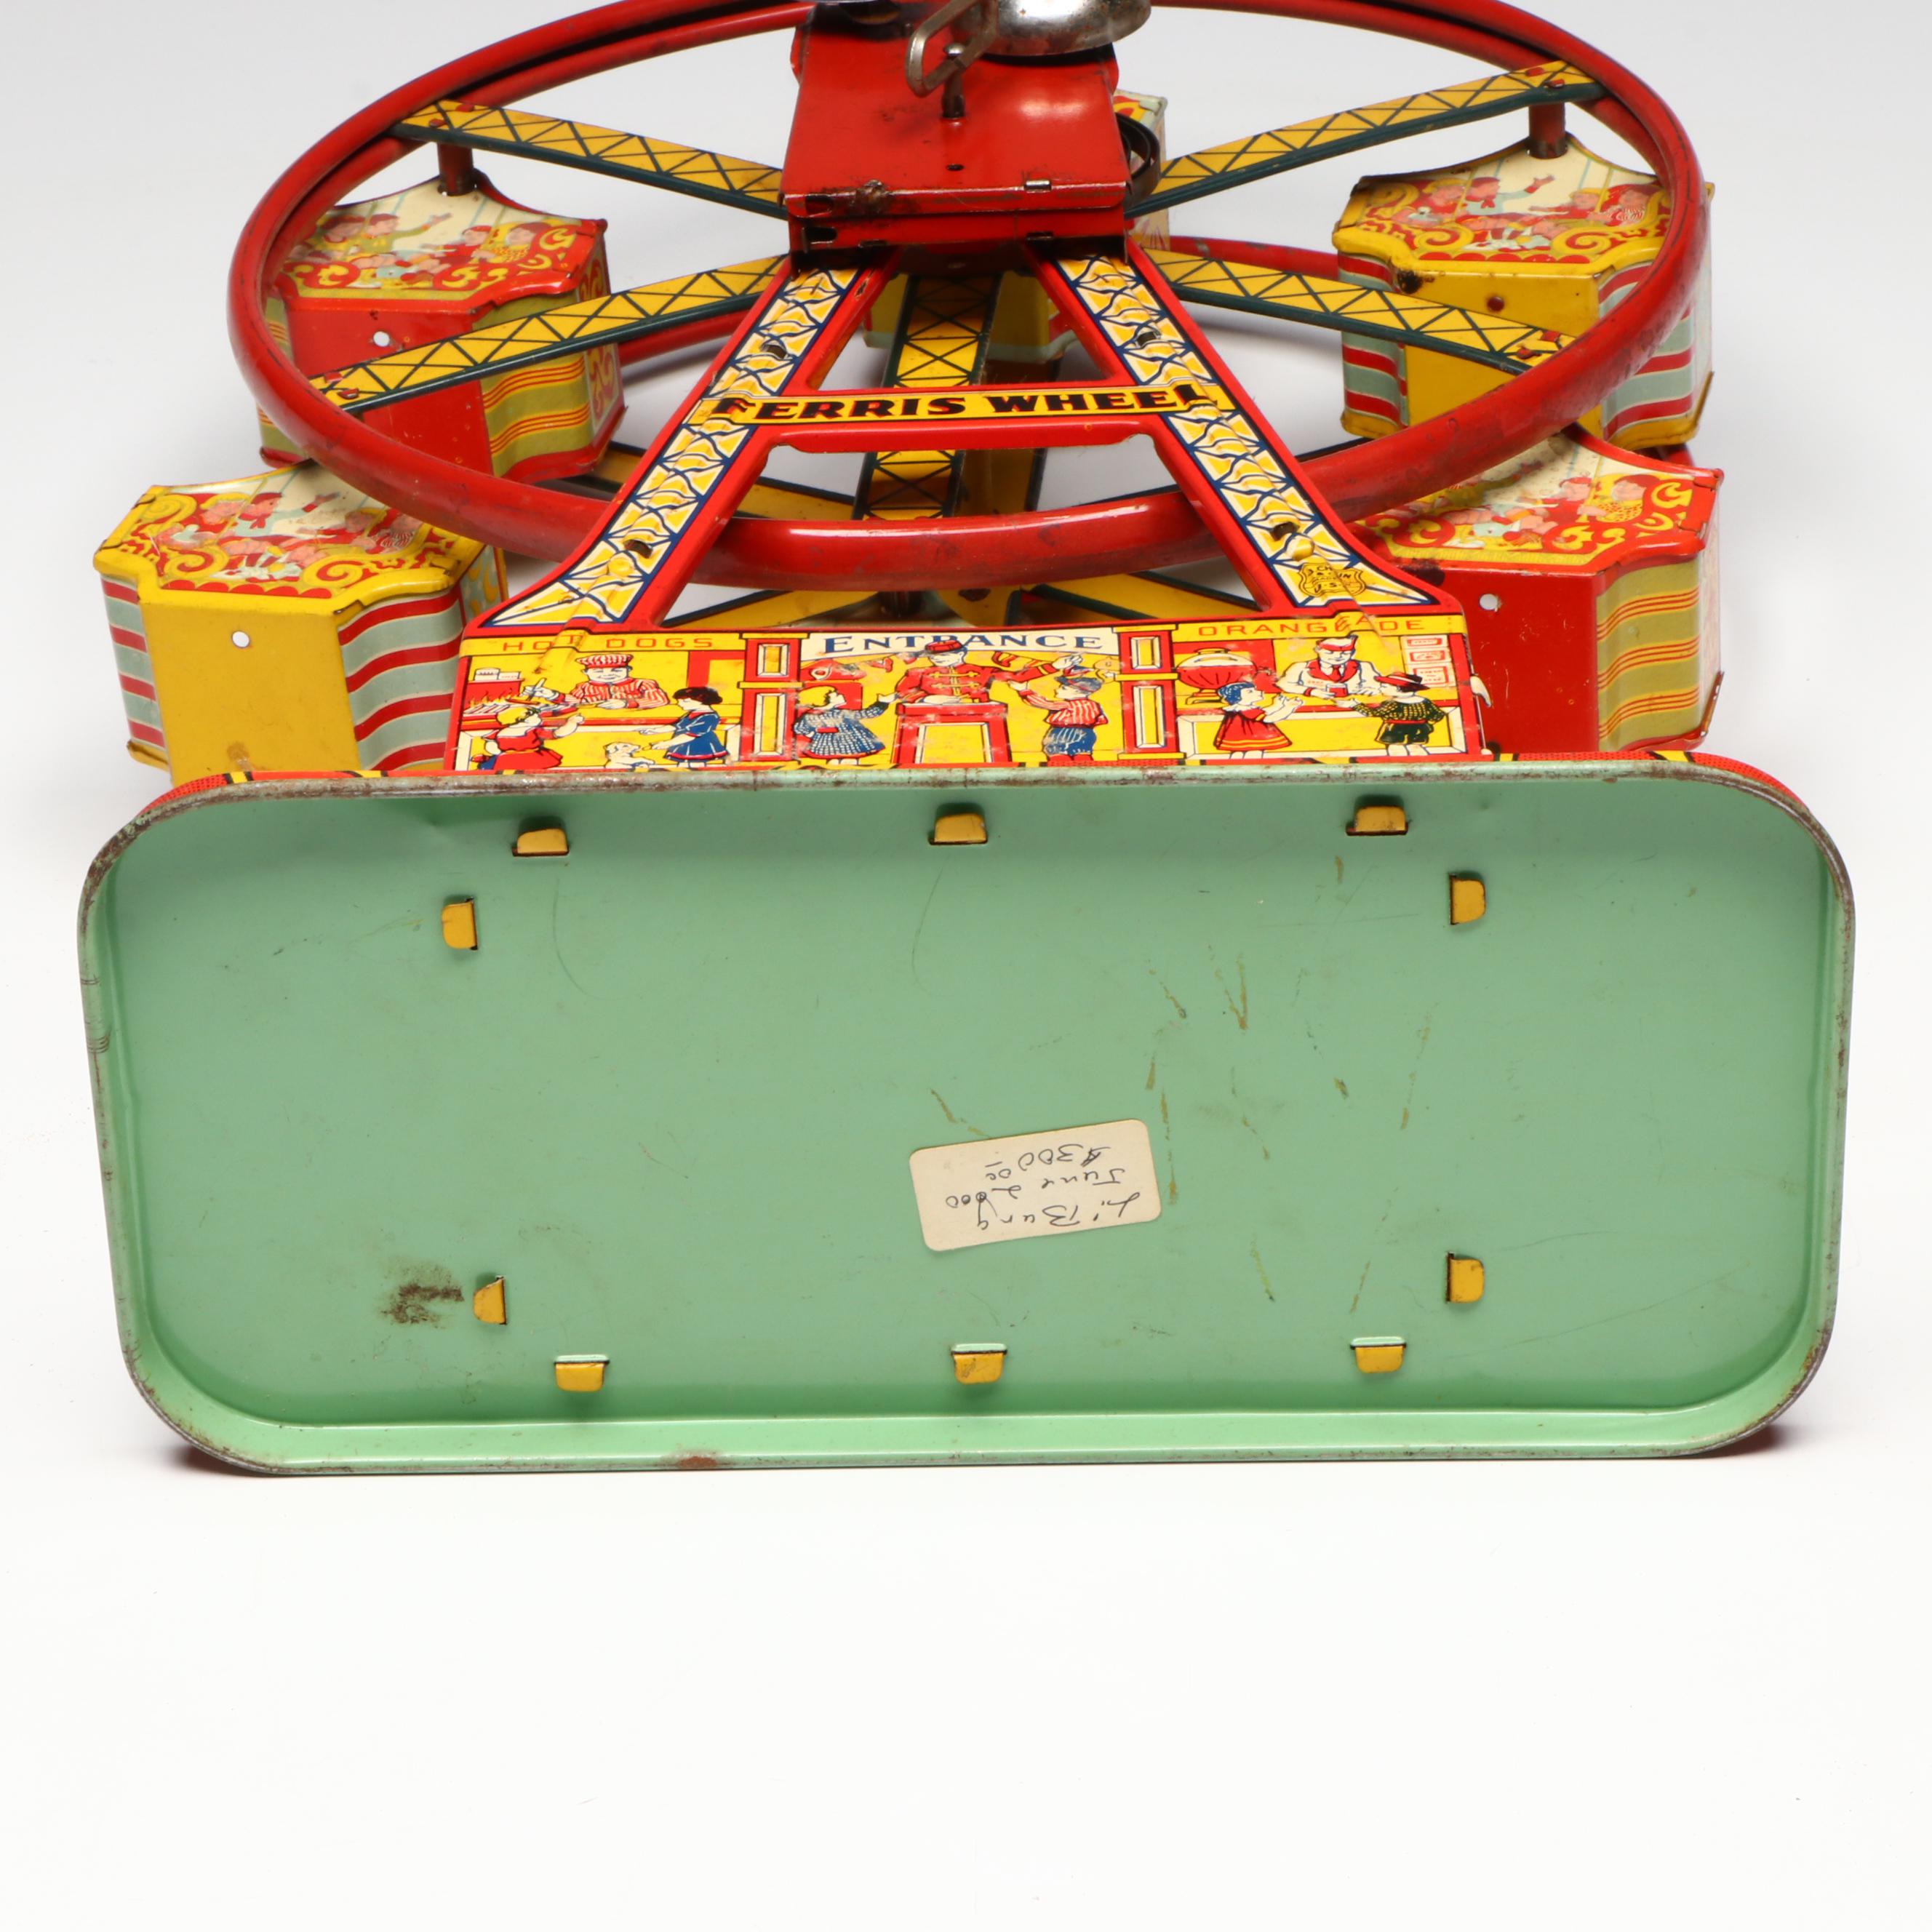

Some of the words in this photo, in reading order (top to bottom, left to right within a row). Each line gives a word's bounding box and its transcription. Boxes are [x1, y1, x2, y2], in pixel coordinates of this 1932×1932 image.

[710, 397, 967, 418] FERRIS
[988, 384, 1218, 415] WHEEL
[503, 634, 583, 652] HOT
[606, 637, 713, 649] DOGS
[1041, 1168, 1125, 1189] June
